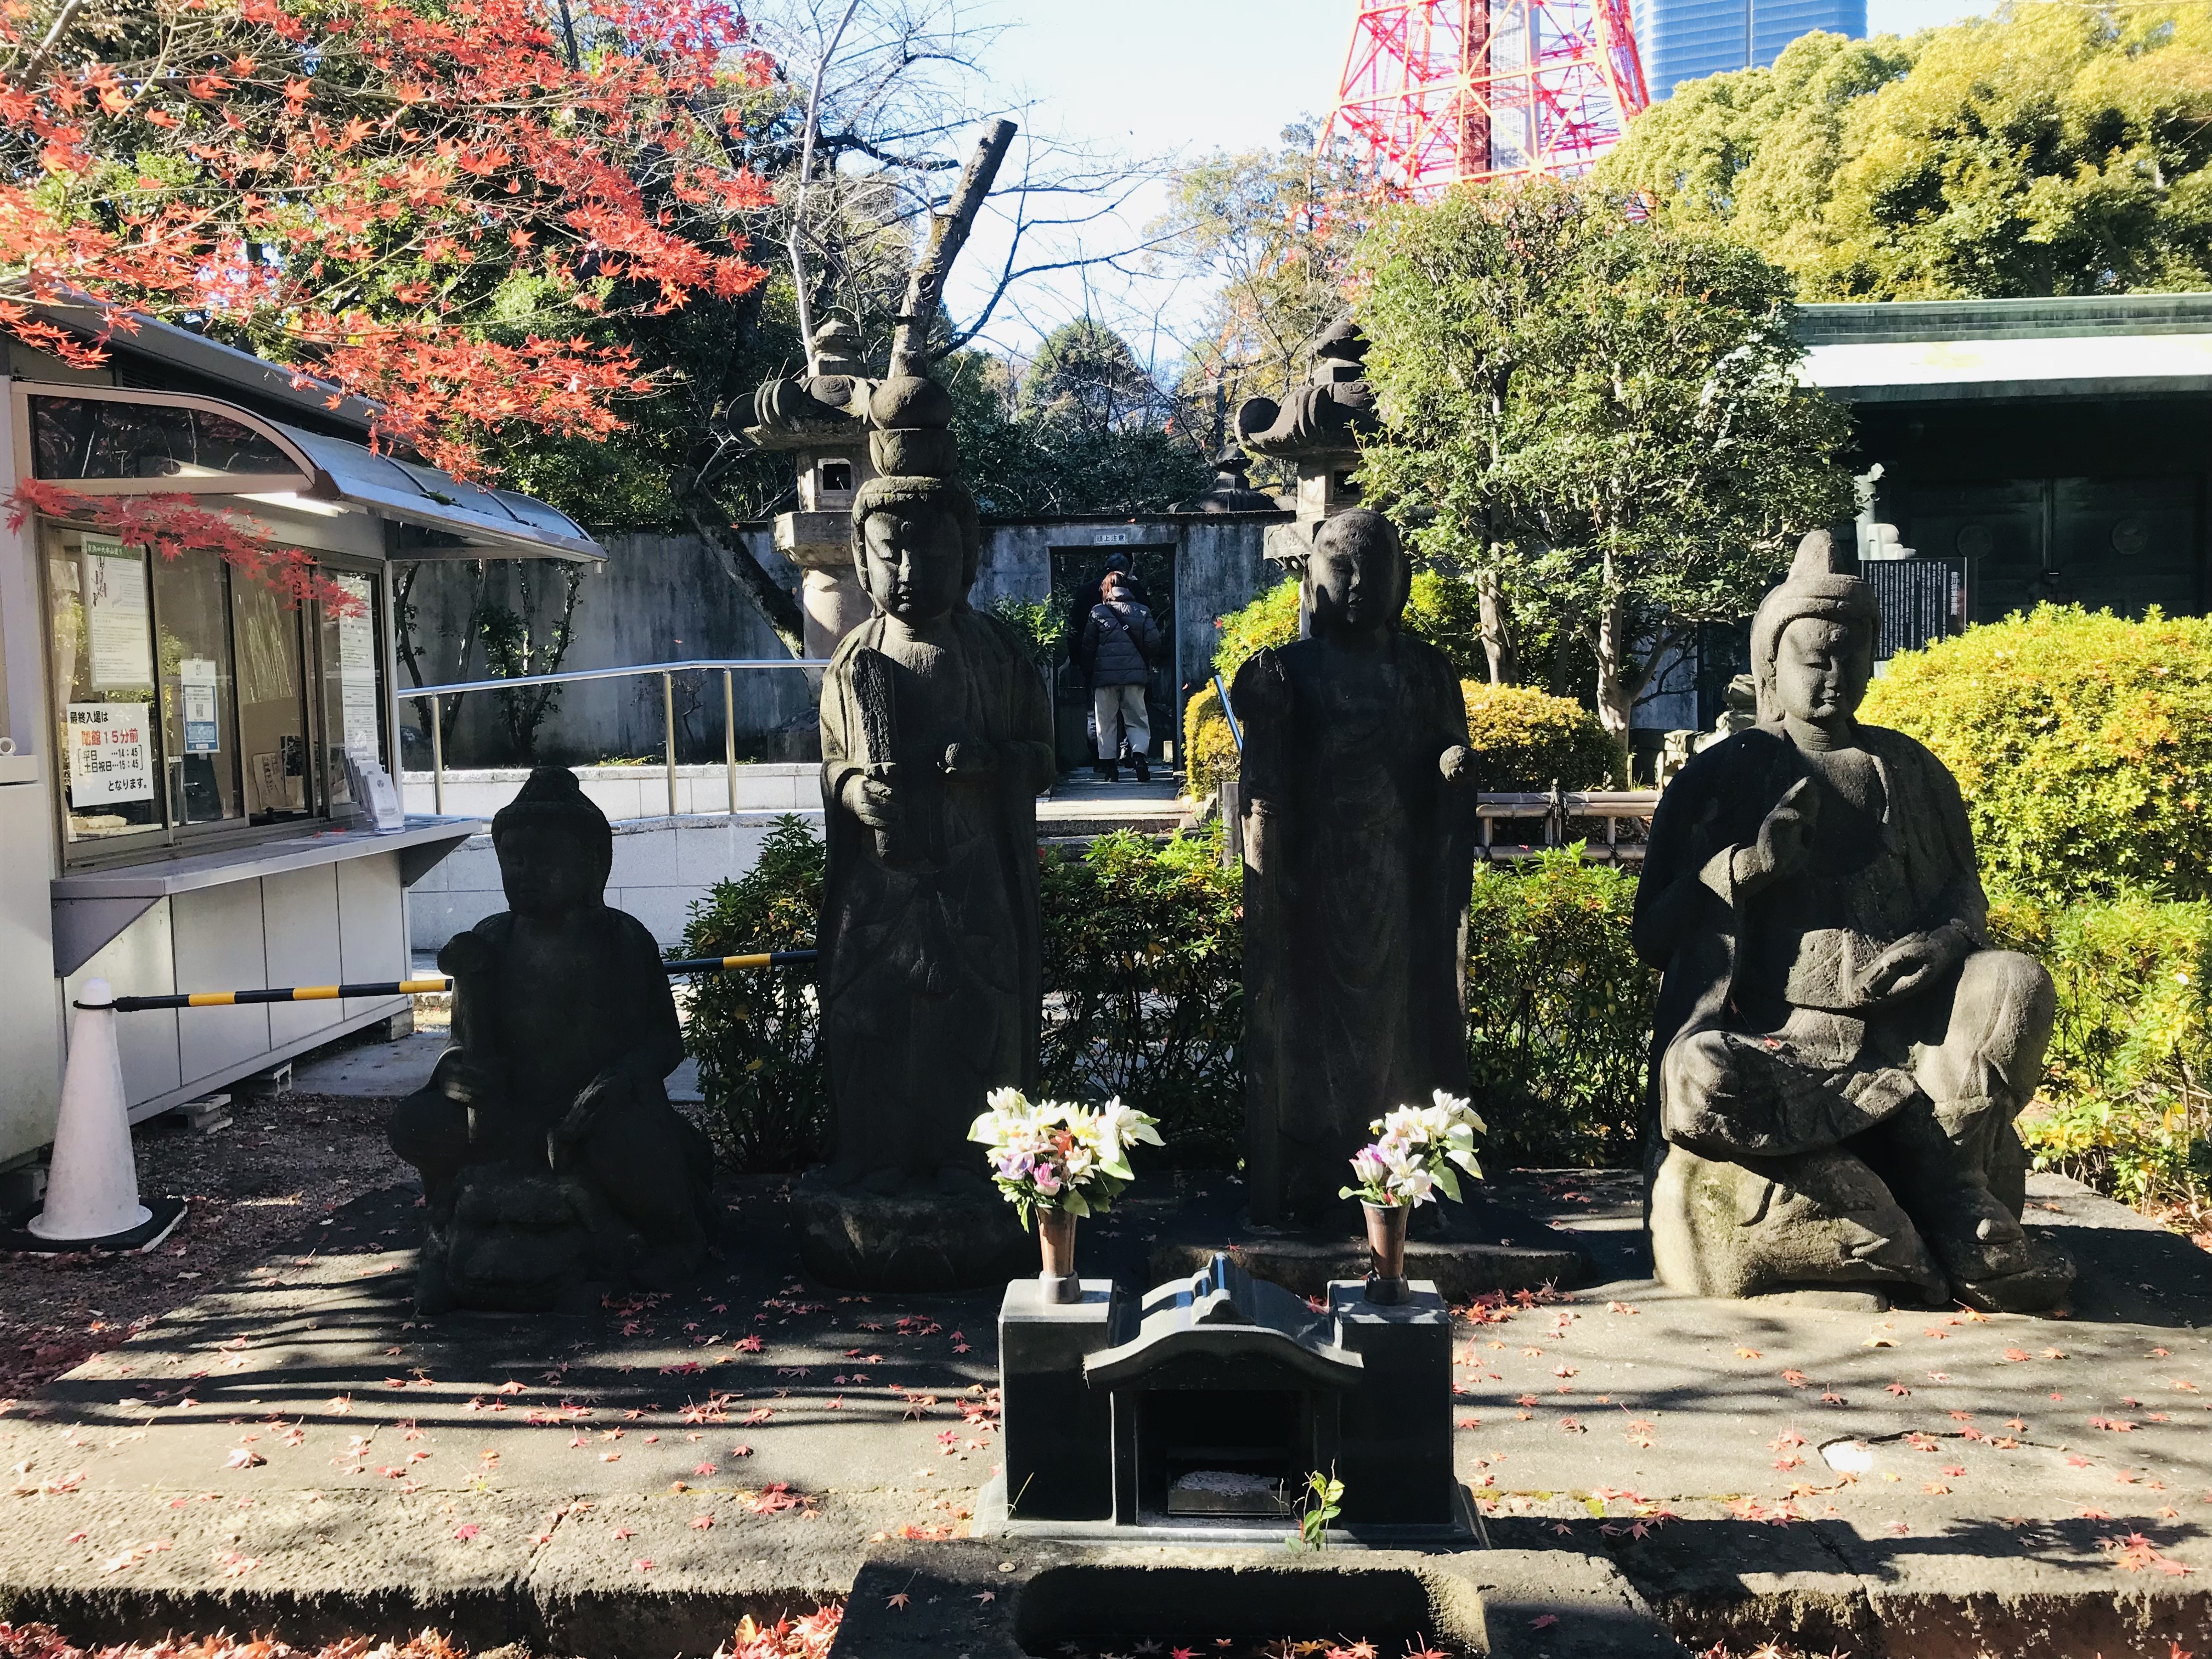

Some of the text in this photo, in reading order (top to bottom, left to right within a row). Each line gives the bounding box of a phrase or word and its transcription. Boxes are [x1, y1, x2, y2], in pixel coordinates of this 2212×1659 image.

[70, 710, 109, 724] 最終入場は
[81, 727, 138, 747] 閉館15分前
[108, 777, 147, 792] となります。
